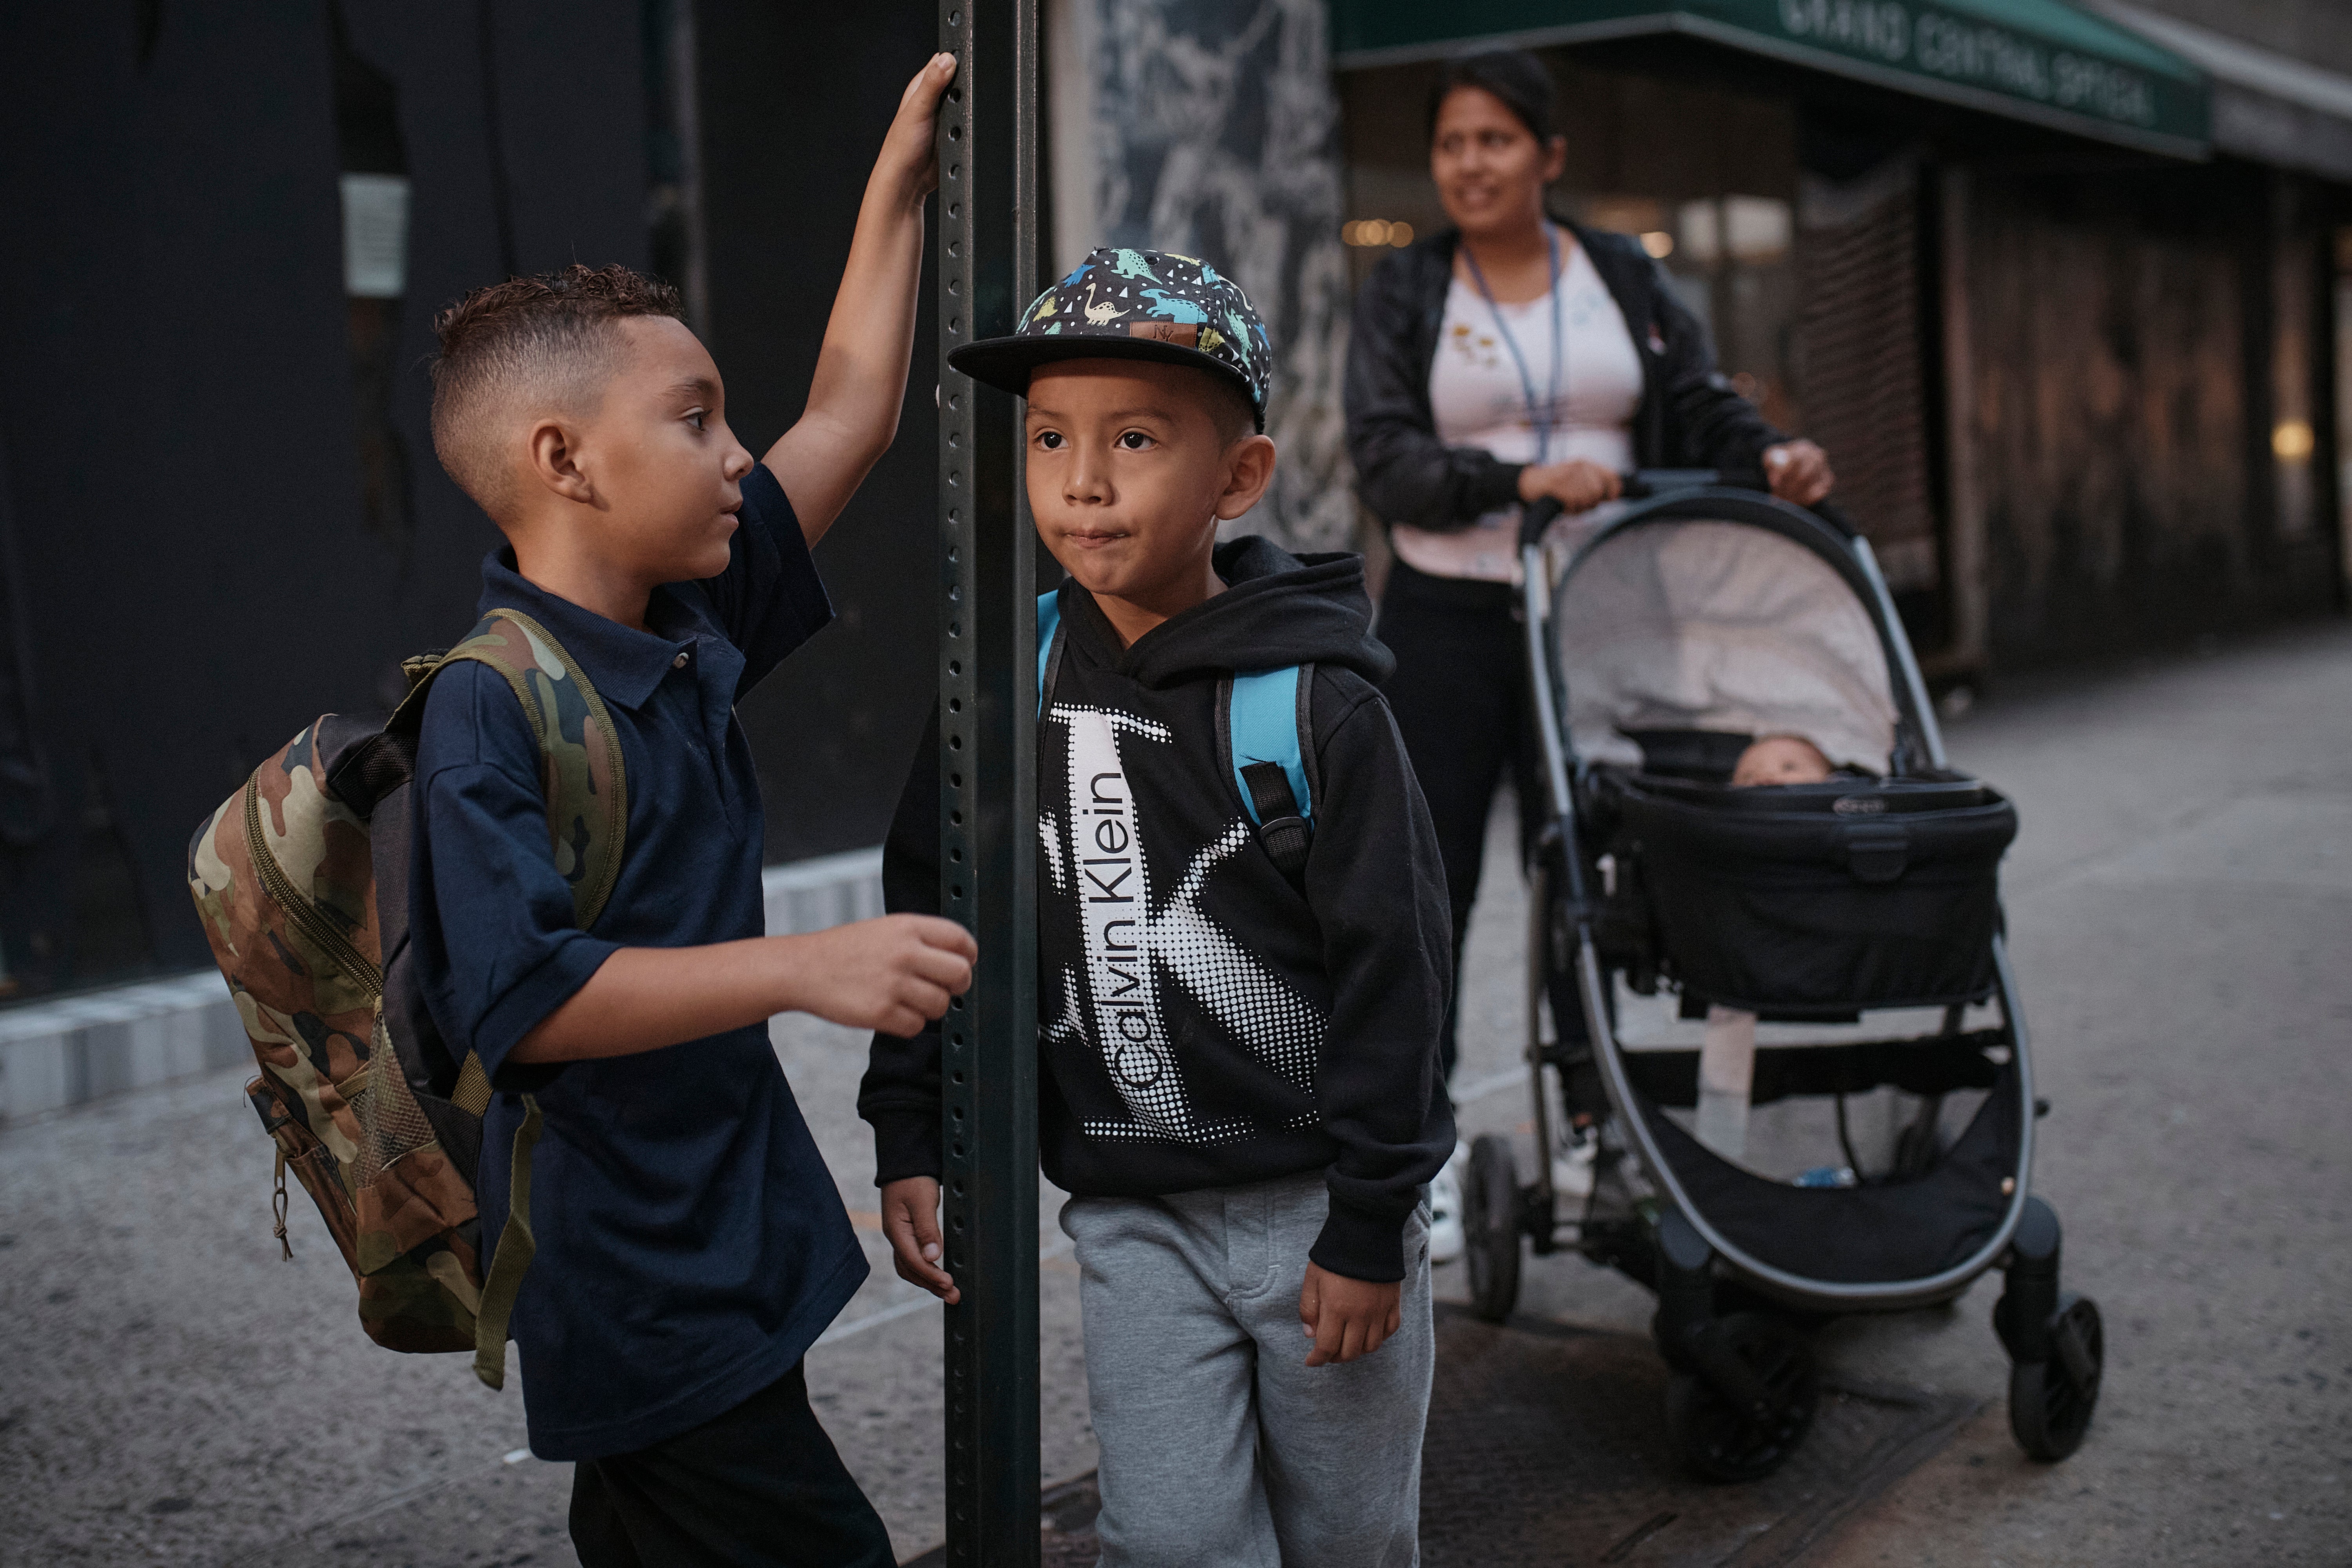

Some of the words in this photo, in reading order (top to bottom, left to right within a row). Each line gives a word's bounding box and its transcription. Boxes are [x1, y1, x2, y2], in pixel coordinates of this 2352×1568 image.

[1152, 325, 1174, 342] NY
[1082, 773, 1134, 902] Klein
[1096, 920, 1163, 1089] Calvin
